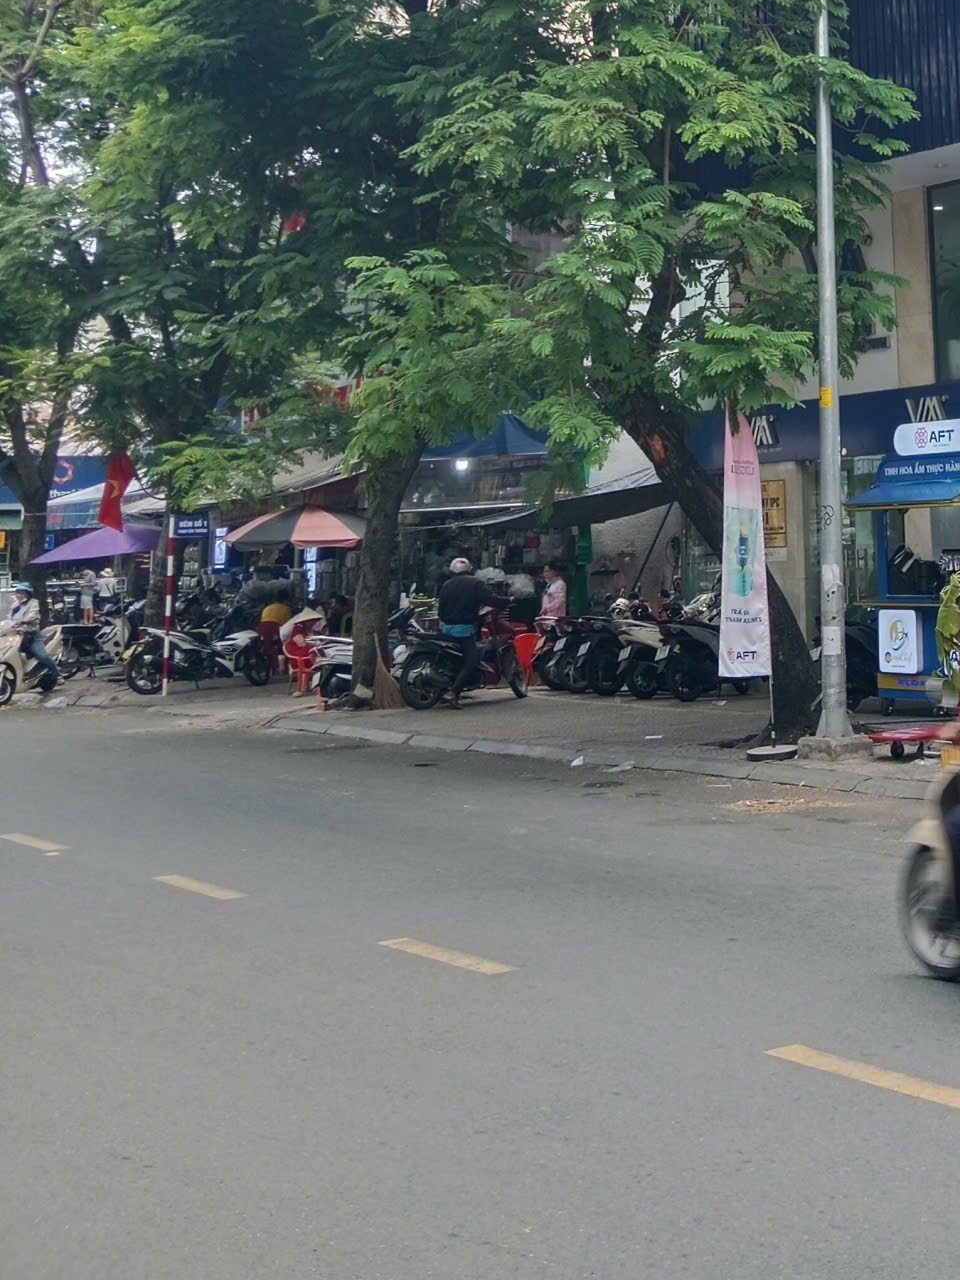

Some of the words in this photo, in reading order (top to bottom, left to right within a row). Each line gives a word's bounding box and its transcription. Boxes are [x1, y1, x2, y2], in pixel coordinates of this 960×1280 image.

[929, 429, 954, 443] AFT
[899, 465, 913, 475] HOA
[736, 651, 757, 660] AFT
